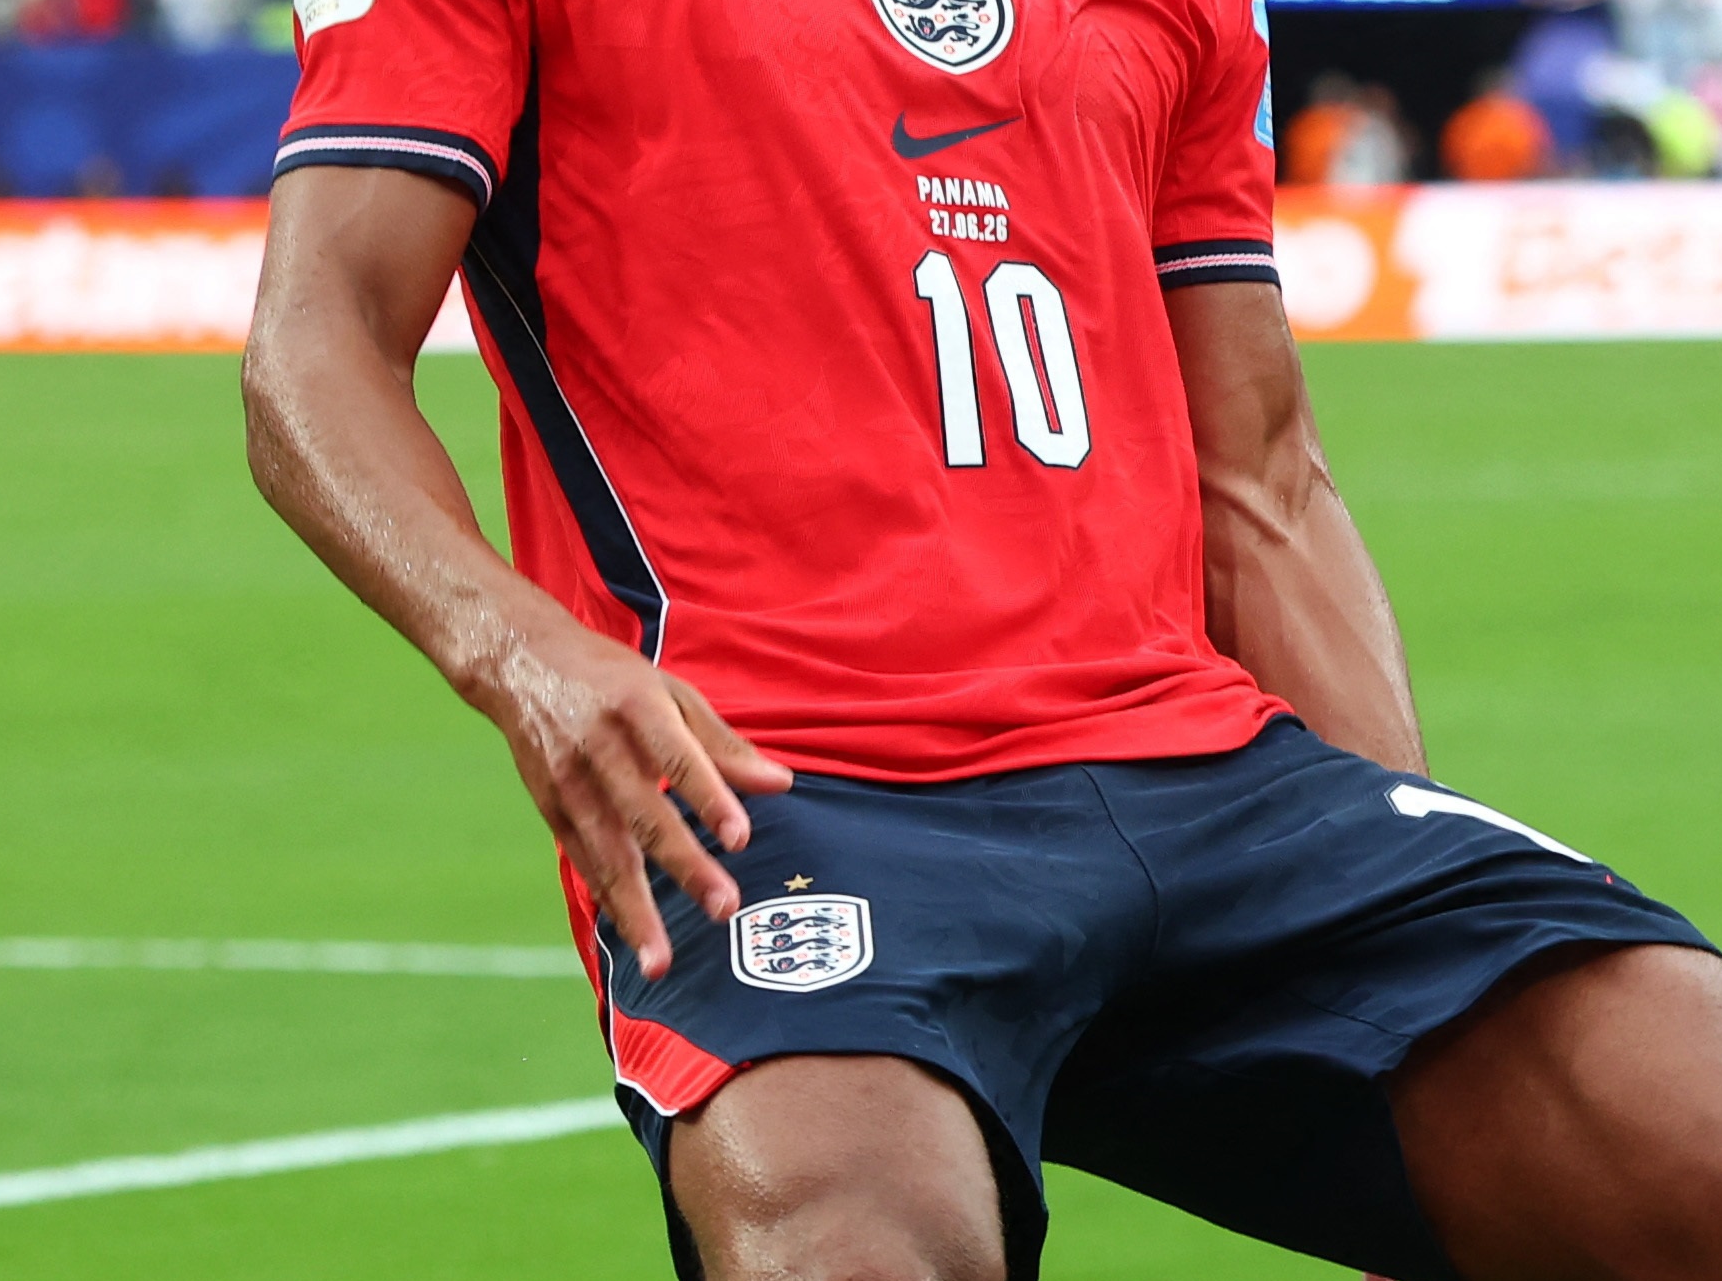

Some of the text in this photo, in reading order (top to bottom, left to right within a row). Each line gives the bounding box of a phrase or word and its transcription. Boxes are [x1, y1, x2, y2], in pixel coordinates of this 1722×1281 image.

[917, 175, 1010, 211] PANAMA
[929, 208, 1008, 243] 27.06.26
[911, 249, 1091, 470] 10
